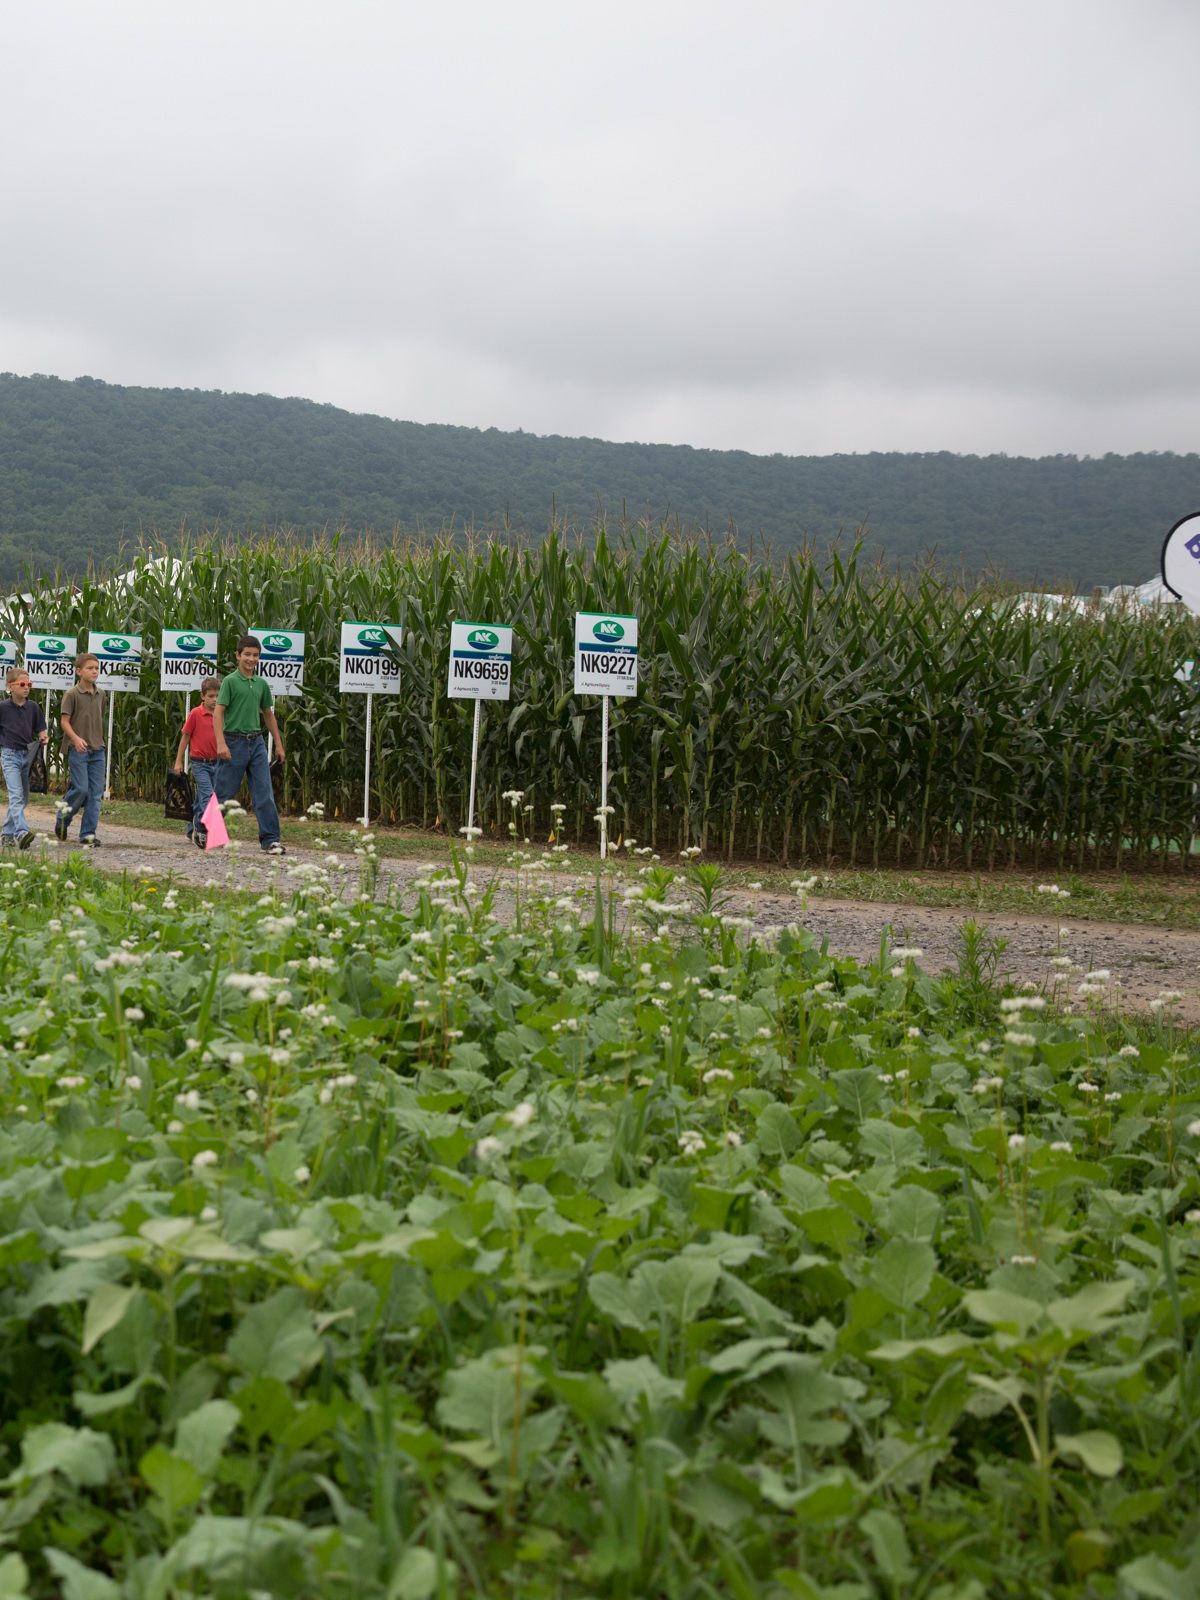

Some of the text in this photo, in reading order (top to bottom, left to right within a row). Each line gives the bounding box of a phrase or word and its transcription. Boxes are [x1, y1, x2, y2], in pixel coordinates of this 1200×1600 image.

[600, 623, 617, 634] NK
[183, 637, 198, 645] NK
[270, 637, 285, 646] NK
[365, 631, 381, 640] NK
[475, 632, 492, 642] NK
[109, 640, 124, 648] NK
[27, 661, 74, 676] NK1263
[165, 660, 215, 676] NK0760
[254, 660, 302, 679] NK0327
[345, 657, 399, 676] NK0199
[454, 660, 509, 680] NK9659
[581, 653, 635, 675] NK9227
